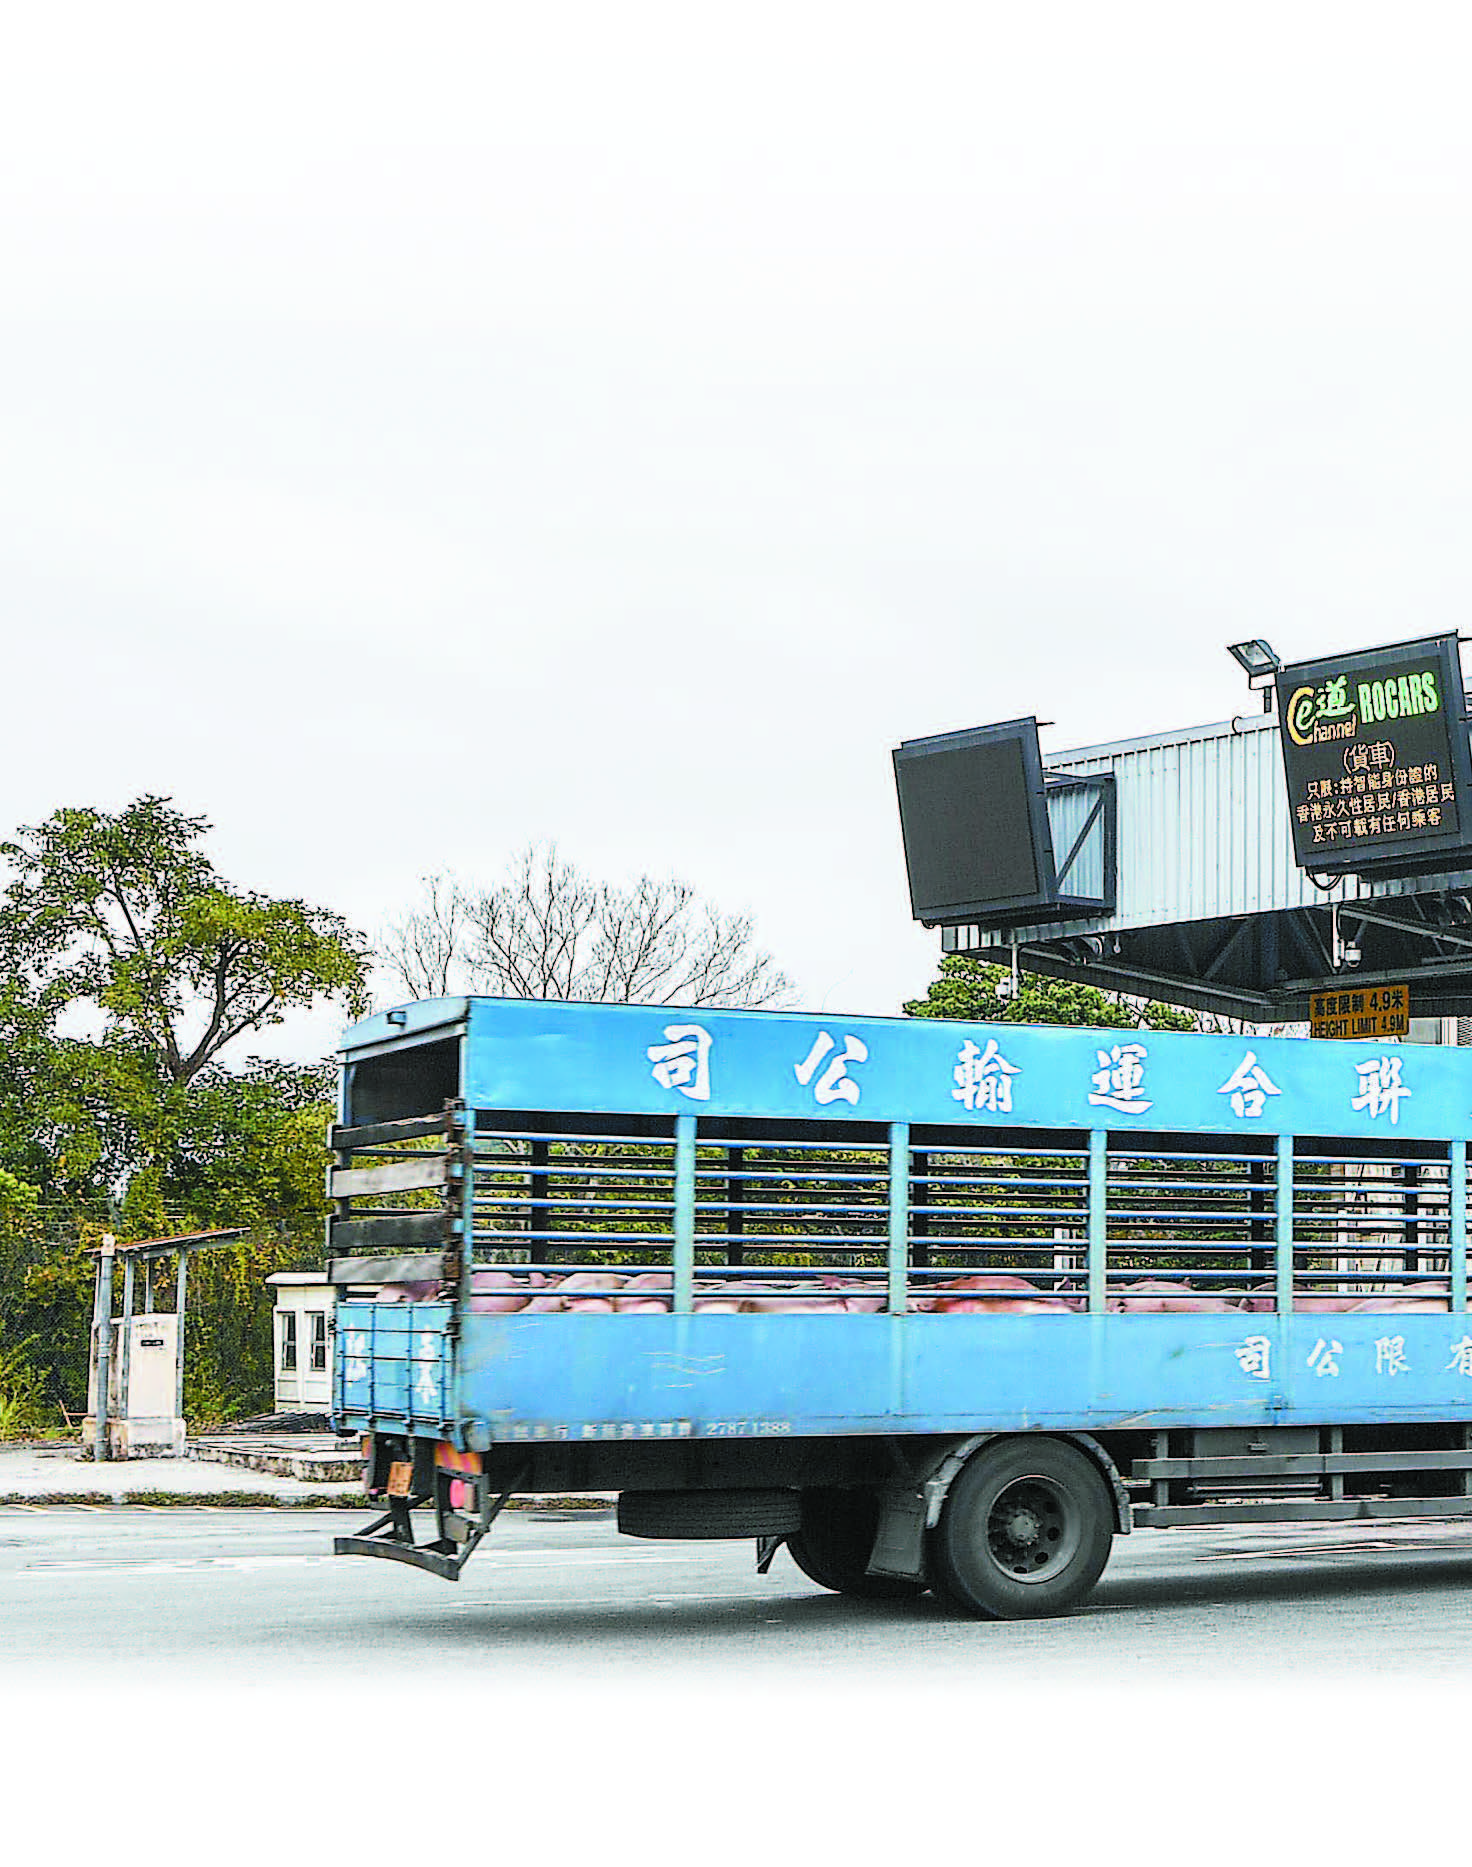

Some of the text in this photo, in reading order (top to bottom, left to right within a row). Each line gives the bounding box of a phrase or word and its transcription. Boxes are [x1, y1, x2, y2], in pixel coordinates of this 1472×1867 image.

[1358, 672, 1438, 723] ROCARS
[1369, 989, 1404, 1012] 4.9米
[1314, 1019, 1349, 1037] HEIGHT
[1351, 1016, 1378, 1035] LIMIT
